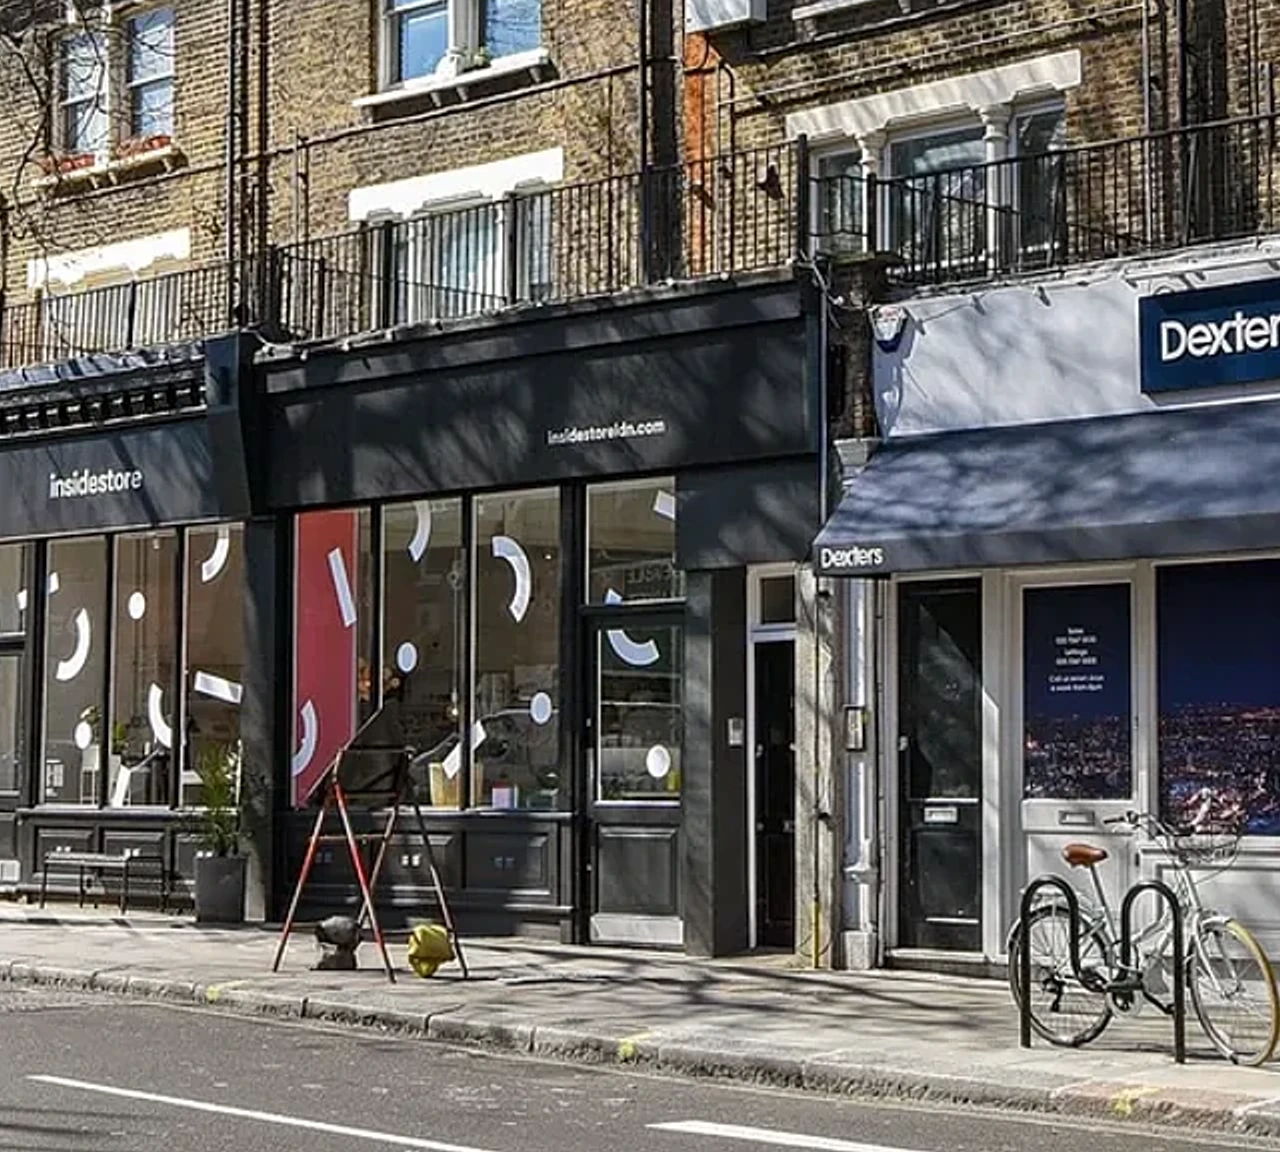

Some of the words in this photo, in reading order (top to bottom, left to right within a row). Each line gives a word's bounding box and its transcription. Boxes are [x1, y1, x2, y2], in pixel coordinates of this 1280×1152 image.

[547, 420, 665, 445] insidestoreldn.com
[49, 468, 143, 499] insidestore
[820, 545, 884, 569] Dexters
